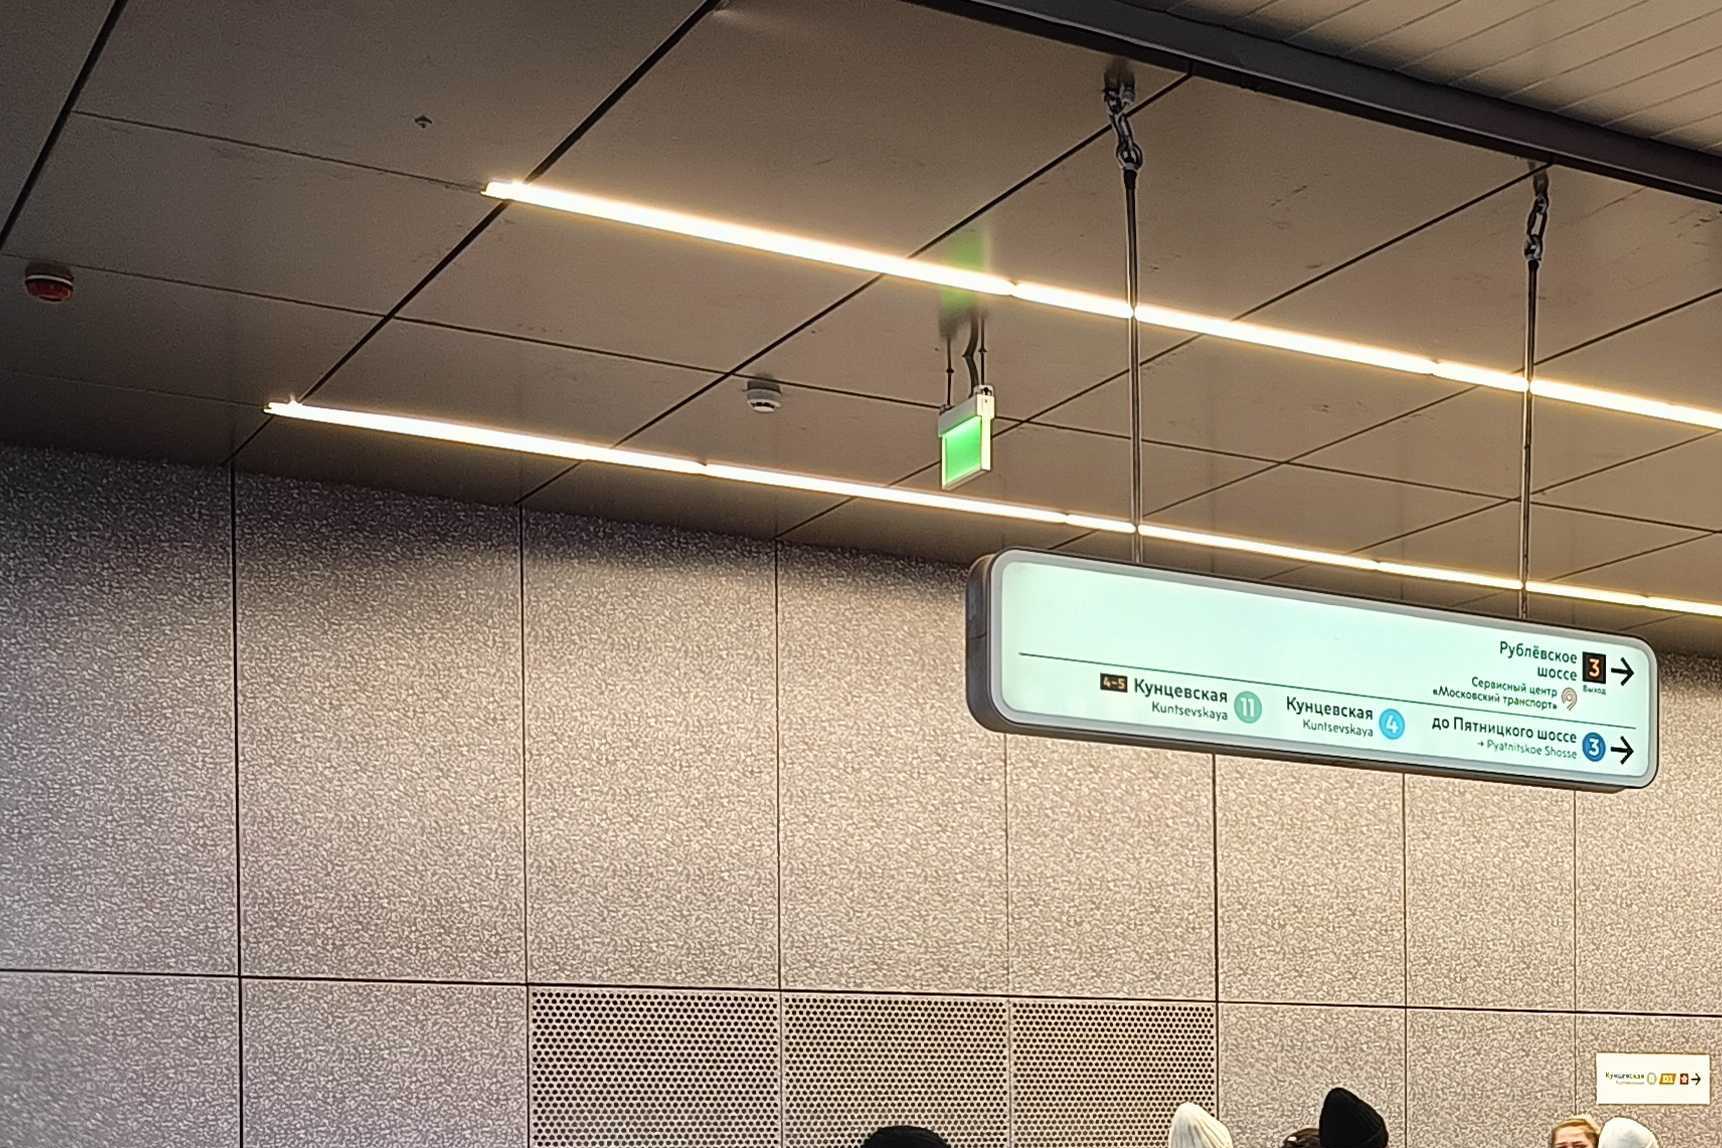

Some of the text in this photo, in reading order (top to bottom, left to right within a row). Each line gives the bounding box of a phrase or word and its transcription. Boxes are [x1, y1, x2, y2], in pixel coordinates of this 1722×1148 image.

[1499, 641, 1578, 664] Рублёвское
[1537, 666, 1578, 682] шоссе
[1587, 657, 1601, 678] 3
[1133, 678, 1228, 703] Кунцевская
[1471, 677, 1558, 698] Сервисный центр
[1151, 701, 1228, 721] Kuntsevskaya
[1240, 697, 1256, 718] 11
[1286, 696, 1374, 721] Кунцевская
[1302, 719, 1374, 737] Kuntsevskaya
[1385, 715, 1399, 734] 4
[1432, 716, 1577, 744] до Пятницкого шоссе
[1487, 739, 1578, 760] Pyatnitskoe Shosse
[1588, 739, 1601, 757] 3
